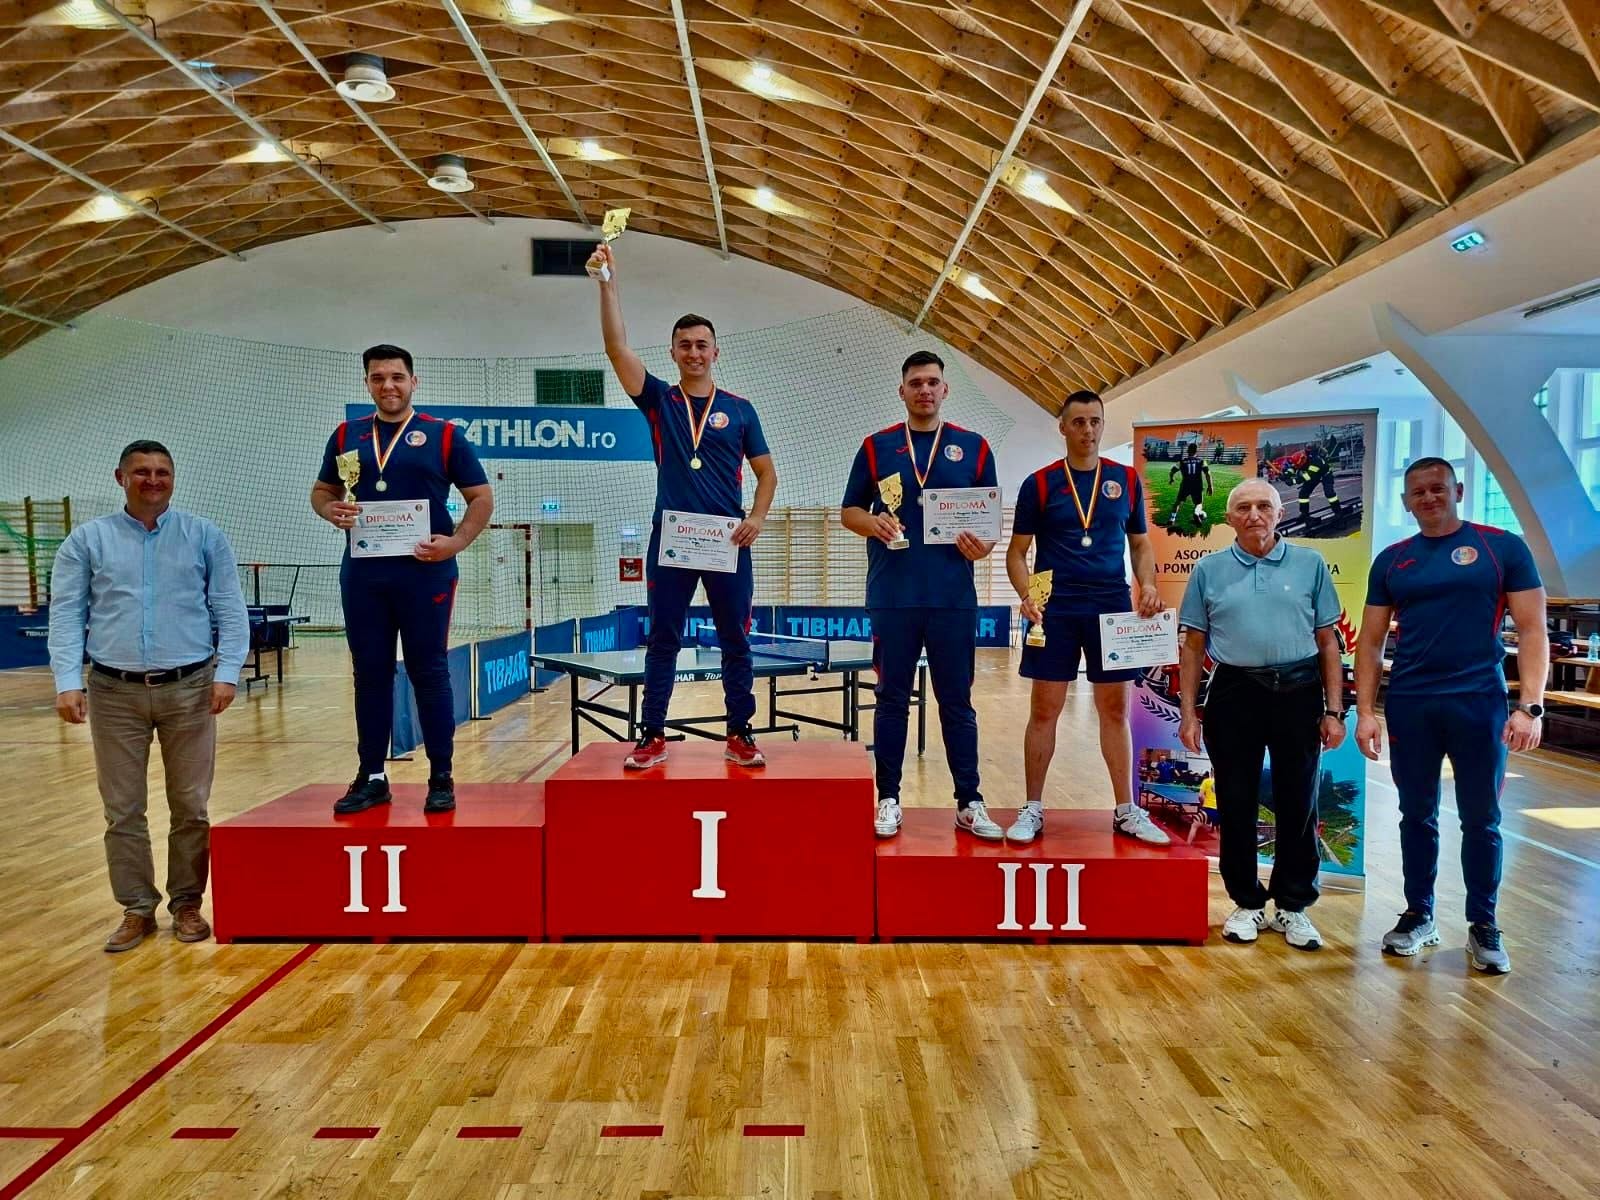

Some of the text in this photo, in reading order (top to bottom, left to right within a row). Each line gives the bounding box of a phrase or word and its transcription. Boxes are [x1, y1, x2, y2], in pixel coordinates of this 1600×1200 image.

[484, 650, 528, 695] TIBHAR
[344, 846, 406, 912] II
[693, 811, 726, 898] I
[997, 863, 1086, 930] III
